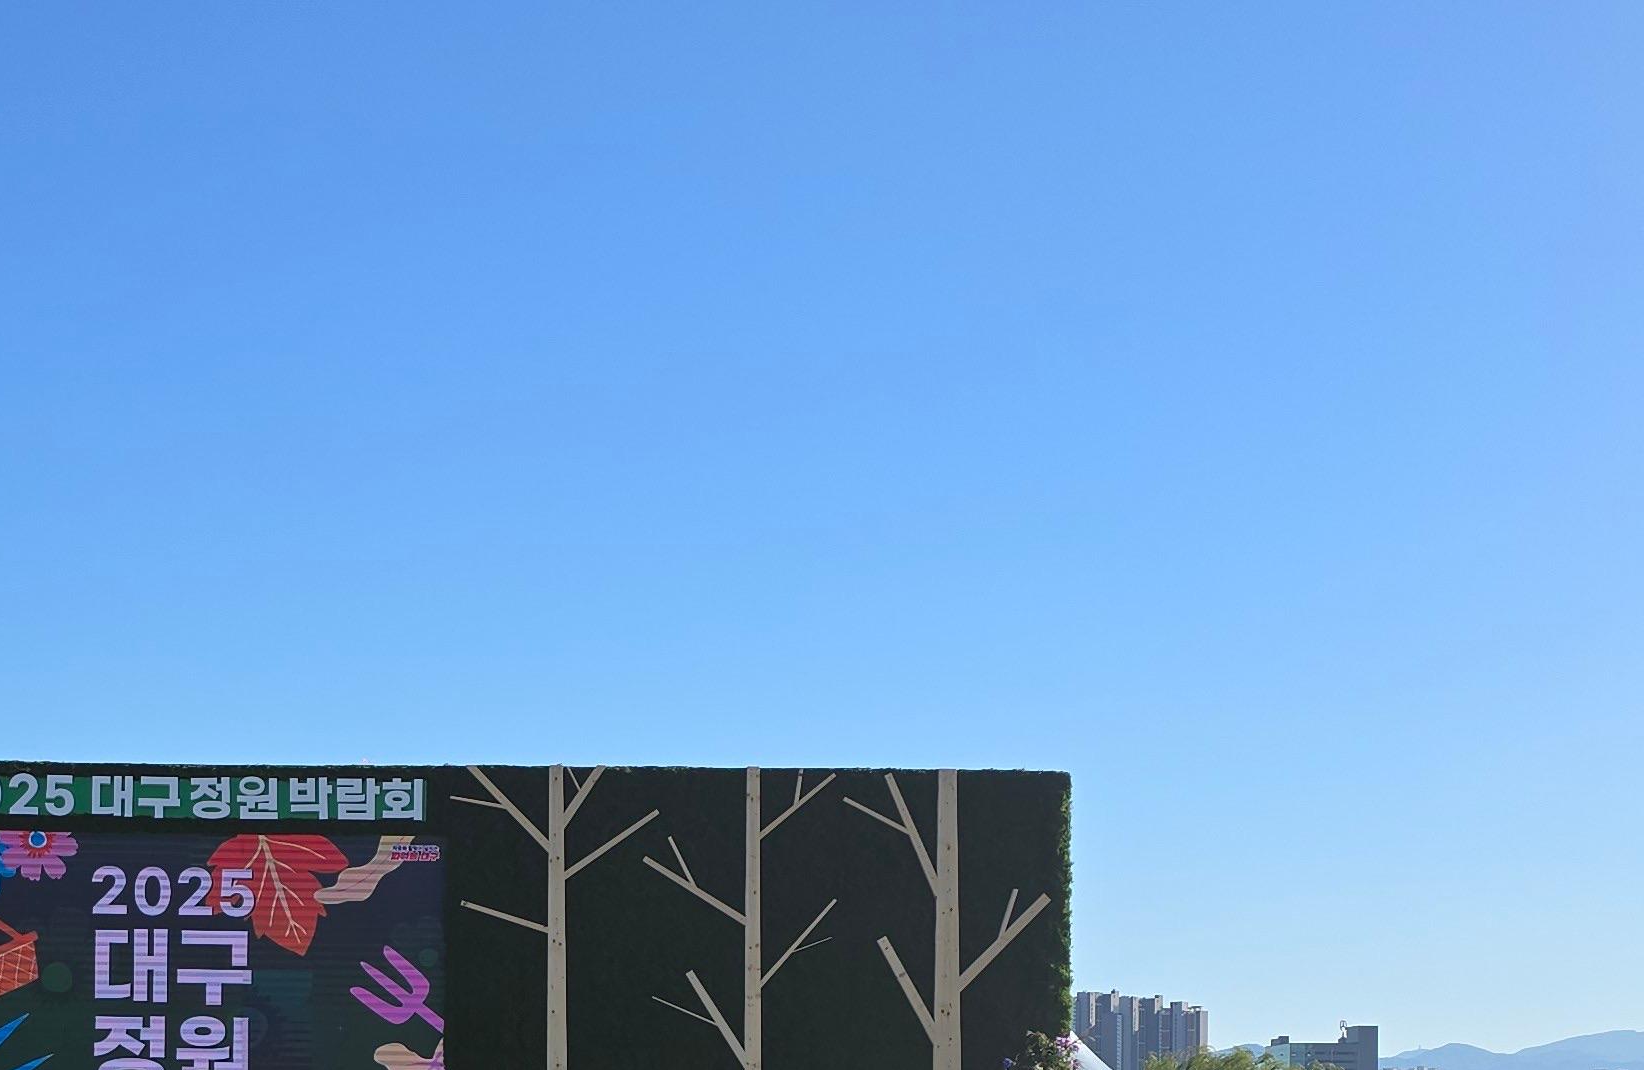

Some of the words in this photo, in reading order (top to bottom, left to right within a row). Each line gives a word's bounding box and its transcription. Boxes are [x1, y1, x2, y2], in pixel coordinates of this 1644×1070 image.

[91, 775, 181, 819] 대구
[190, 777, 279, 819] 정원
[289, 777, 424, 821] 박람회
[91, 867, 255, 917] 2025
[94, 928, 252, 1006] 대구
